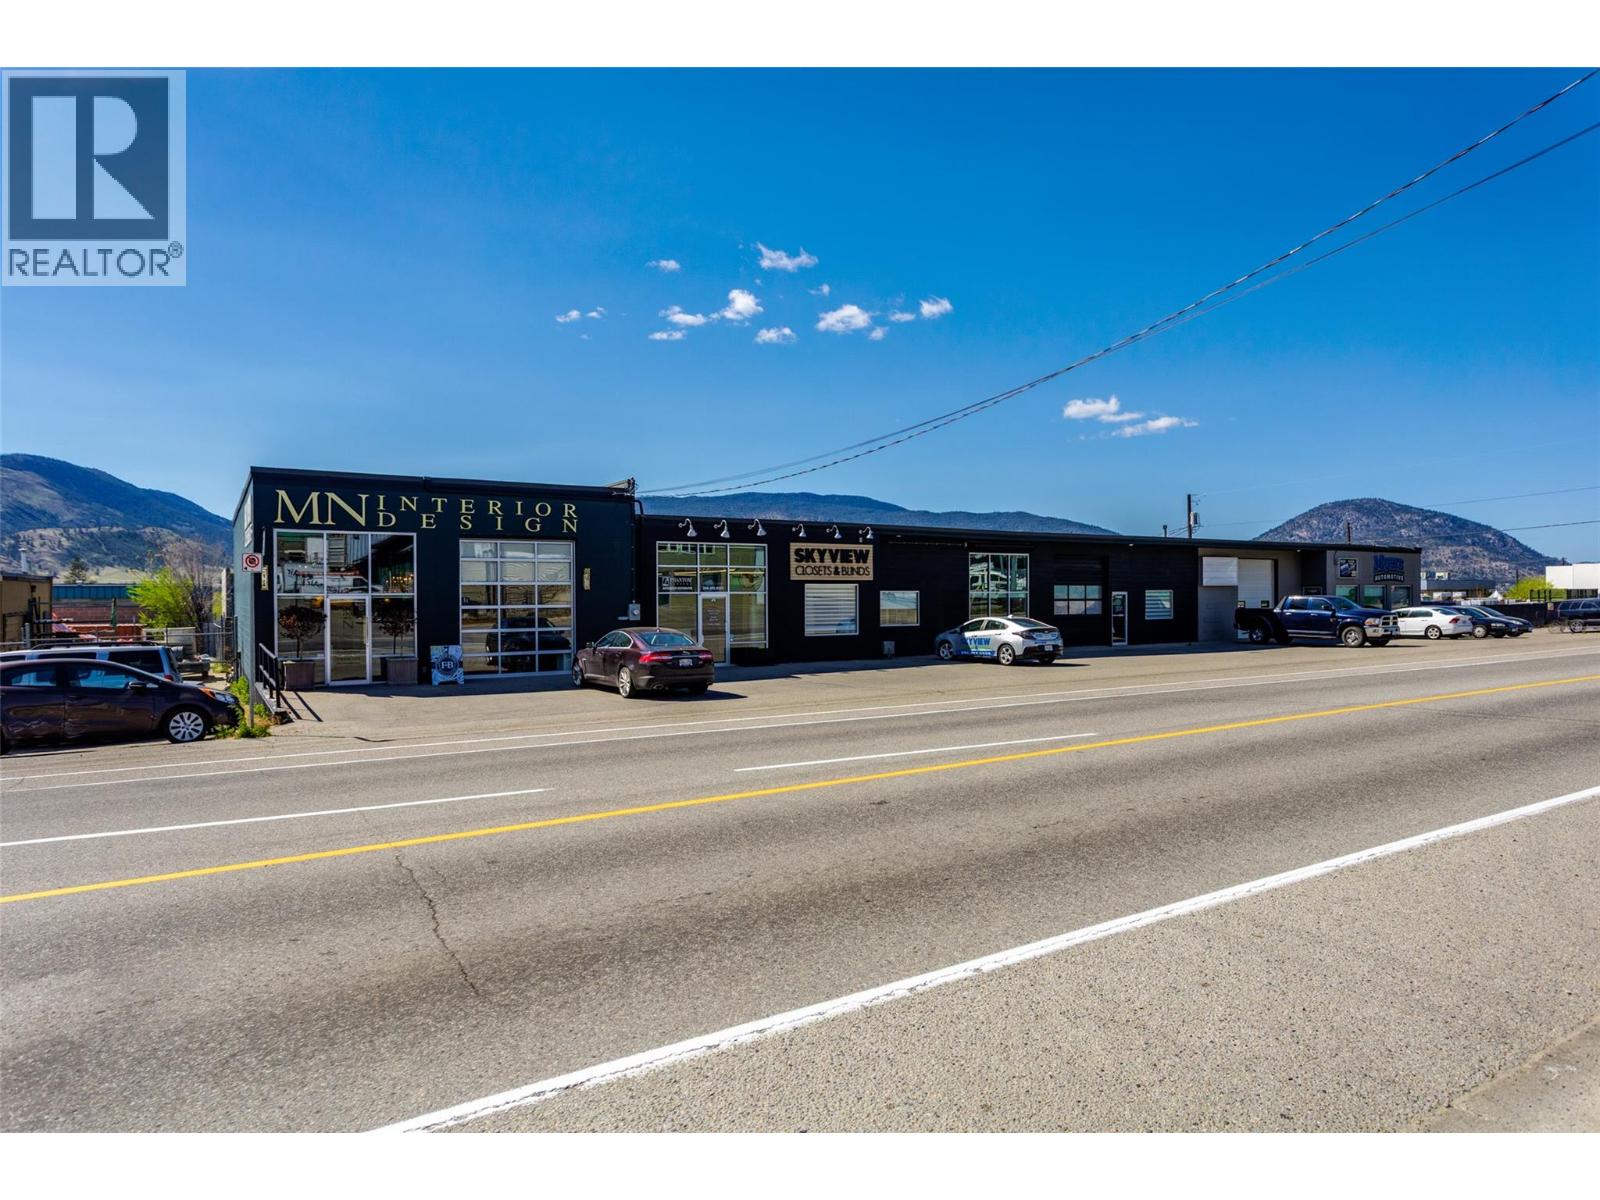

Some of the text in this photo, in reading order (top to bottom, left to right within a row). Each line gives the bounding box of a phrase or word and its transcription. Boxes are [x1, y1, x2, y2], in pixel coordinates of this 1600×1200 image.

[274, 489, 578, 527] MN INTERIOR
[376, 511, 578, 533] DESIGN
[794, 548, 870, 563] SKYVIEW
[795, 565, 871, 576] CLOSETS & BLINDS
[1374, 574, 1404, 582] AUTOMOTIVE
